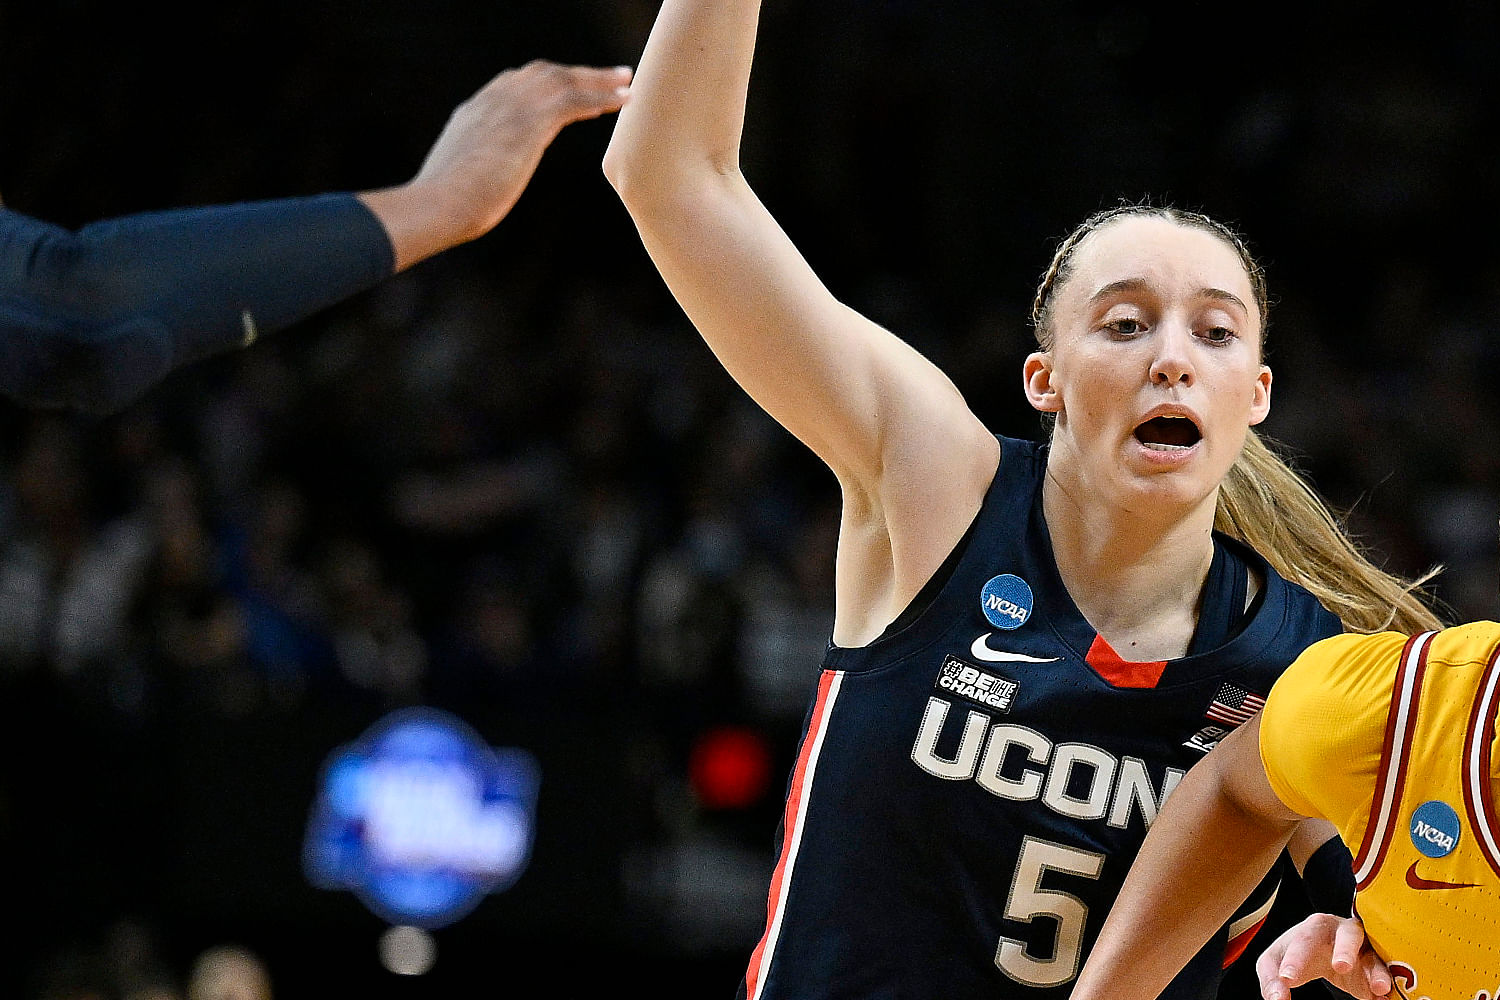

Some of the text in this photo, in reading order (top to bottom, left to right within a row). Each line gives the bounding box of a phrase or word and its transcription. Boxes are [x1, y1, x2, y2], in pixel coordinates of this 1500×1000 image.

[985, 593, 1028, 623] NCAA
[939, 675, 1011, 709] CHANGE
[1413, 820, 1454, 852] NCAA
[994, 833, 1106, 988] 5
